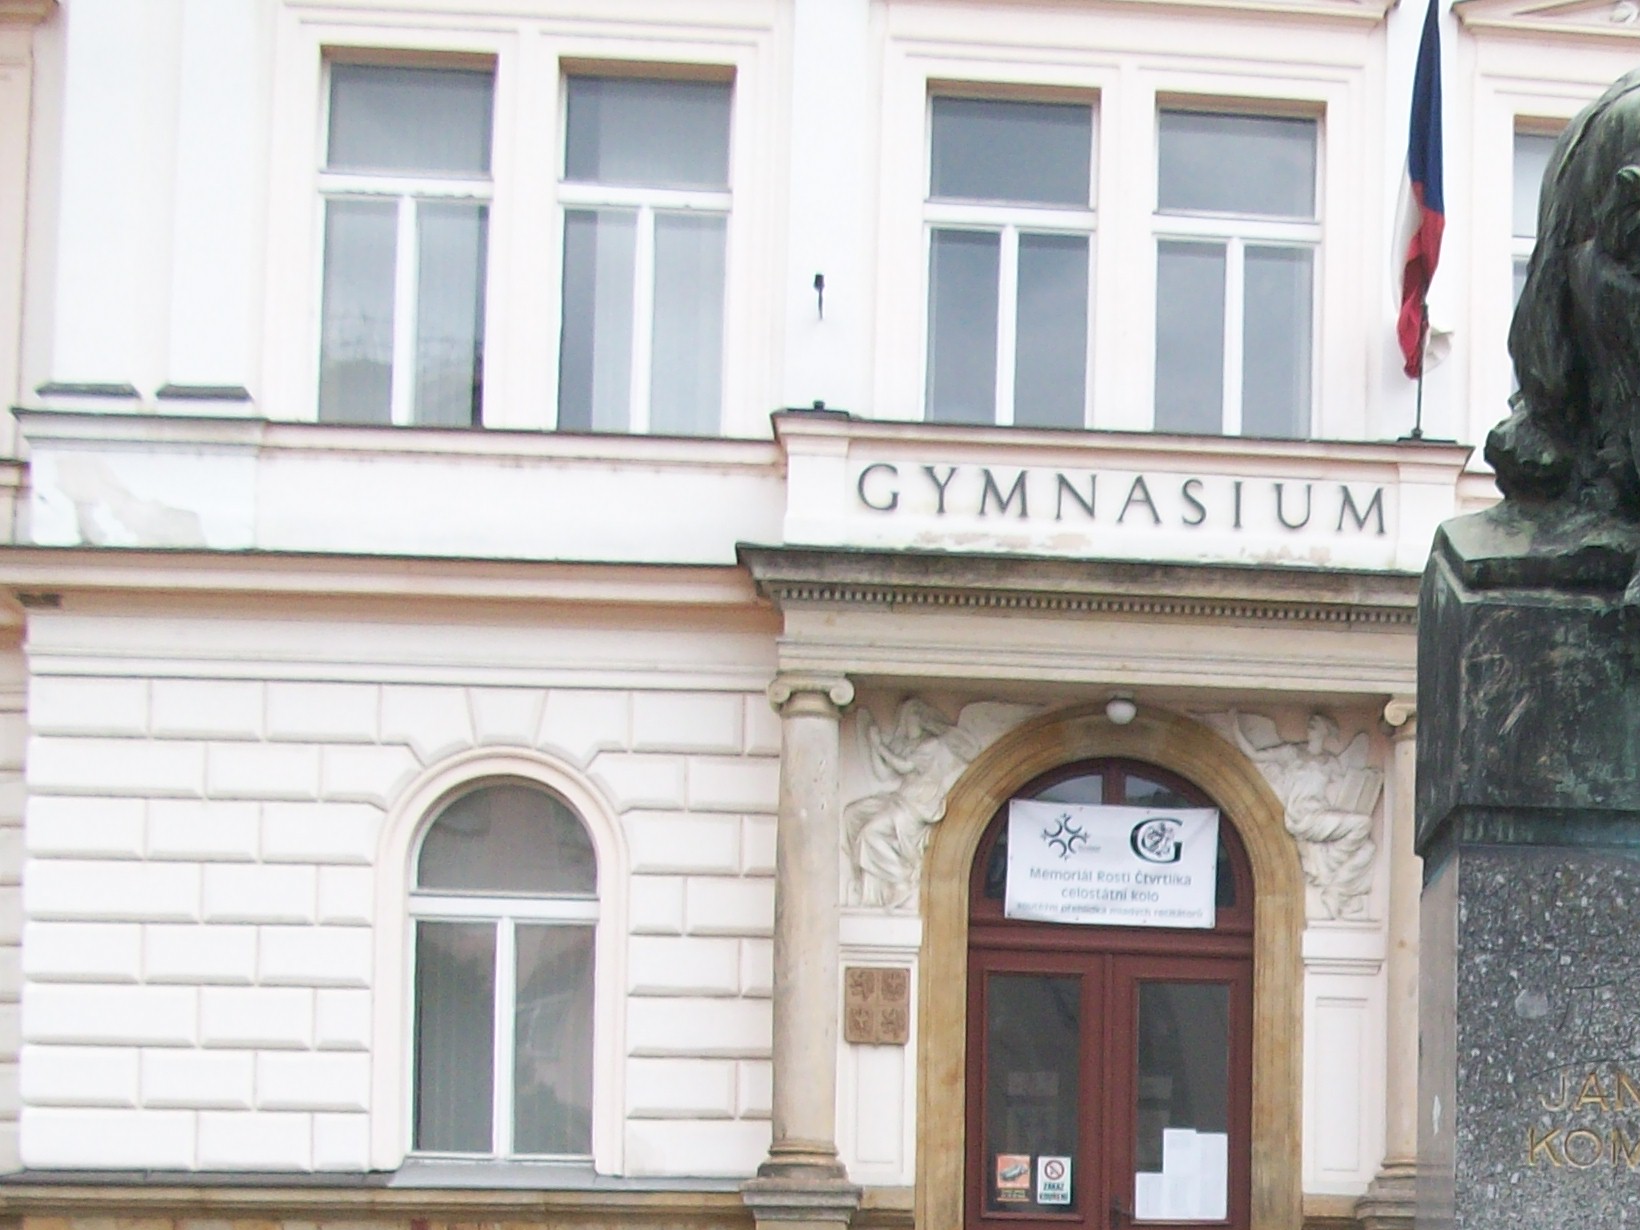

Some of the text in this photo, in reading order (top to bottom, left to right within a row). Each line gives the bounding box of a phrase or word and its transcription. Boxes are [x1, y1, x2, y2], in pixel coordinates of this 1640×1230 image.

[857, 463, 1387, 535] GYMNASIUM
[1030, 867, 1093, 882] Memoriál
[1061, 886, 1159, 902] celostátní kolo
